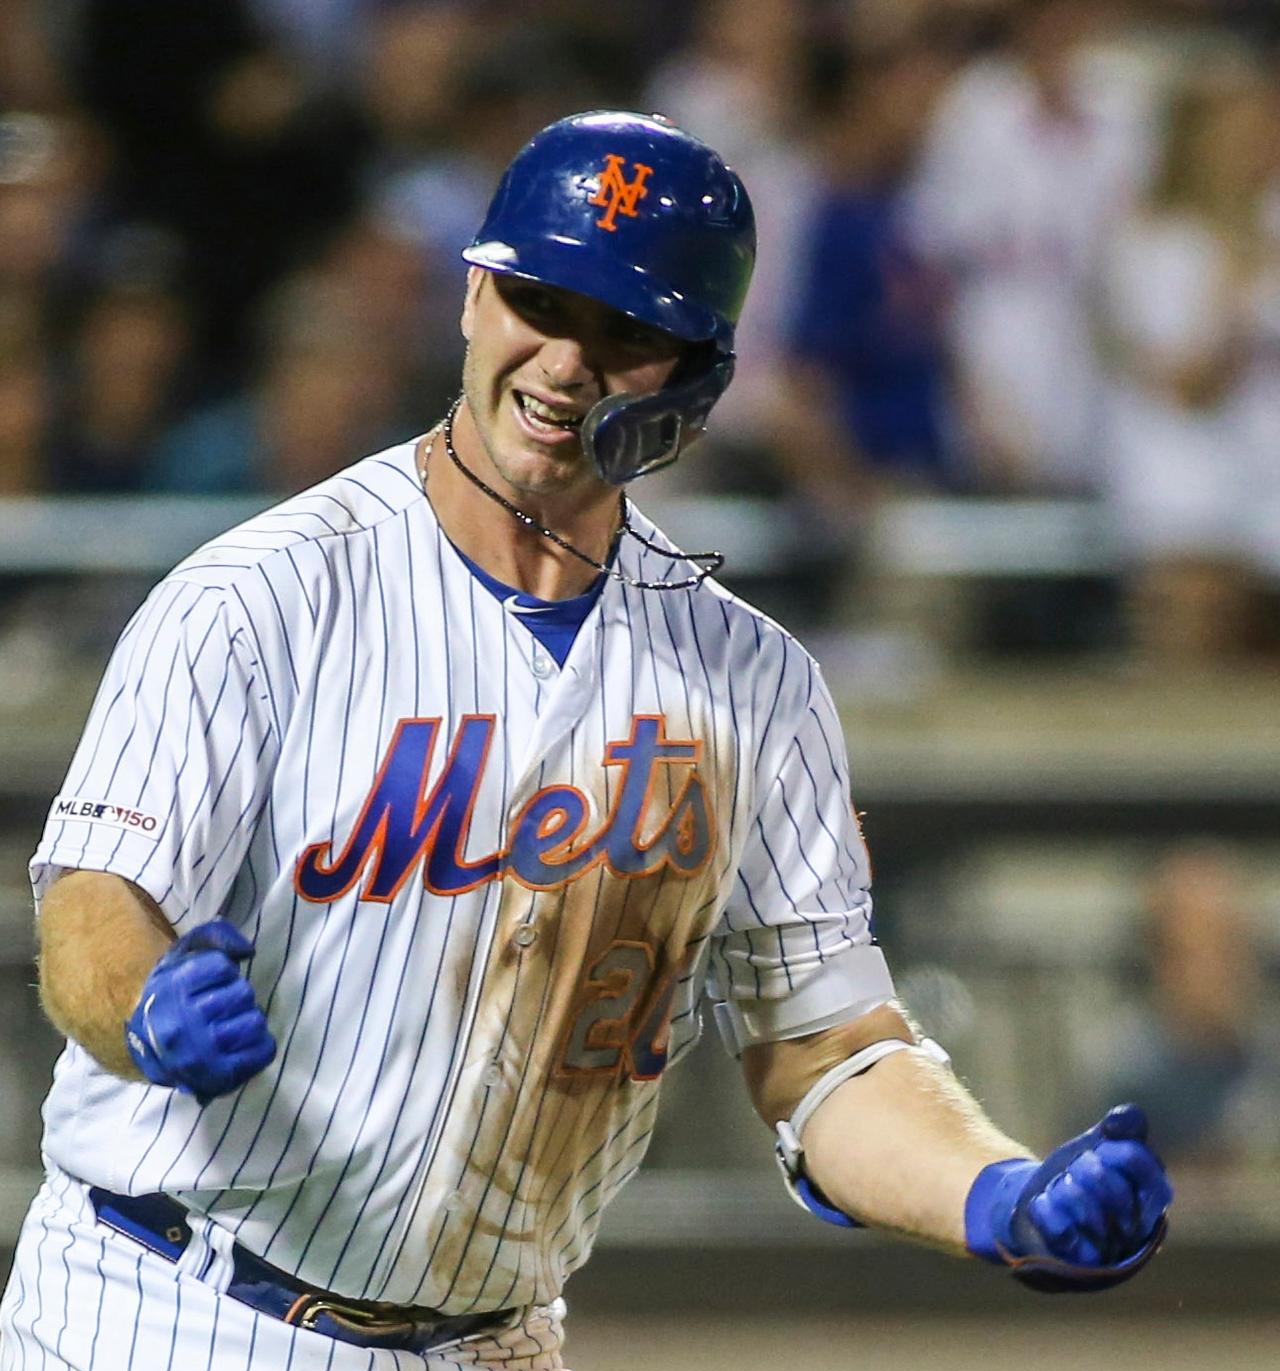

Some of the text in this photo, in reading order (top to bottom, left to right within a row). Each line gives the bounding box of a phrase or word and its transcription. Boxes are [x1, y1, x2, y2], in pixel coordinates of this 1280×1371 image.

[55, 800, 158, 832] MLB 150
[294, 712, 717, 903] Mets
